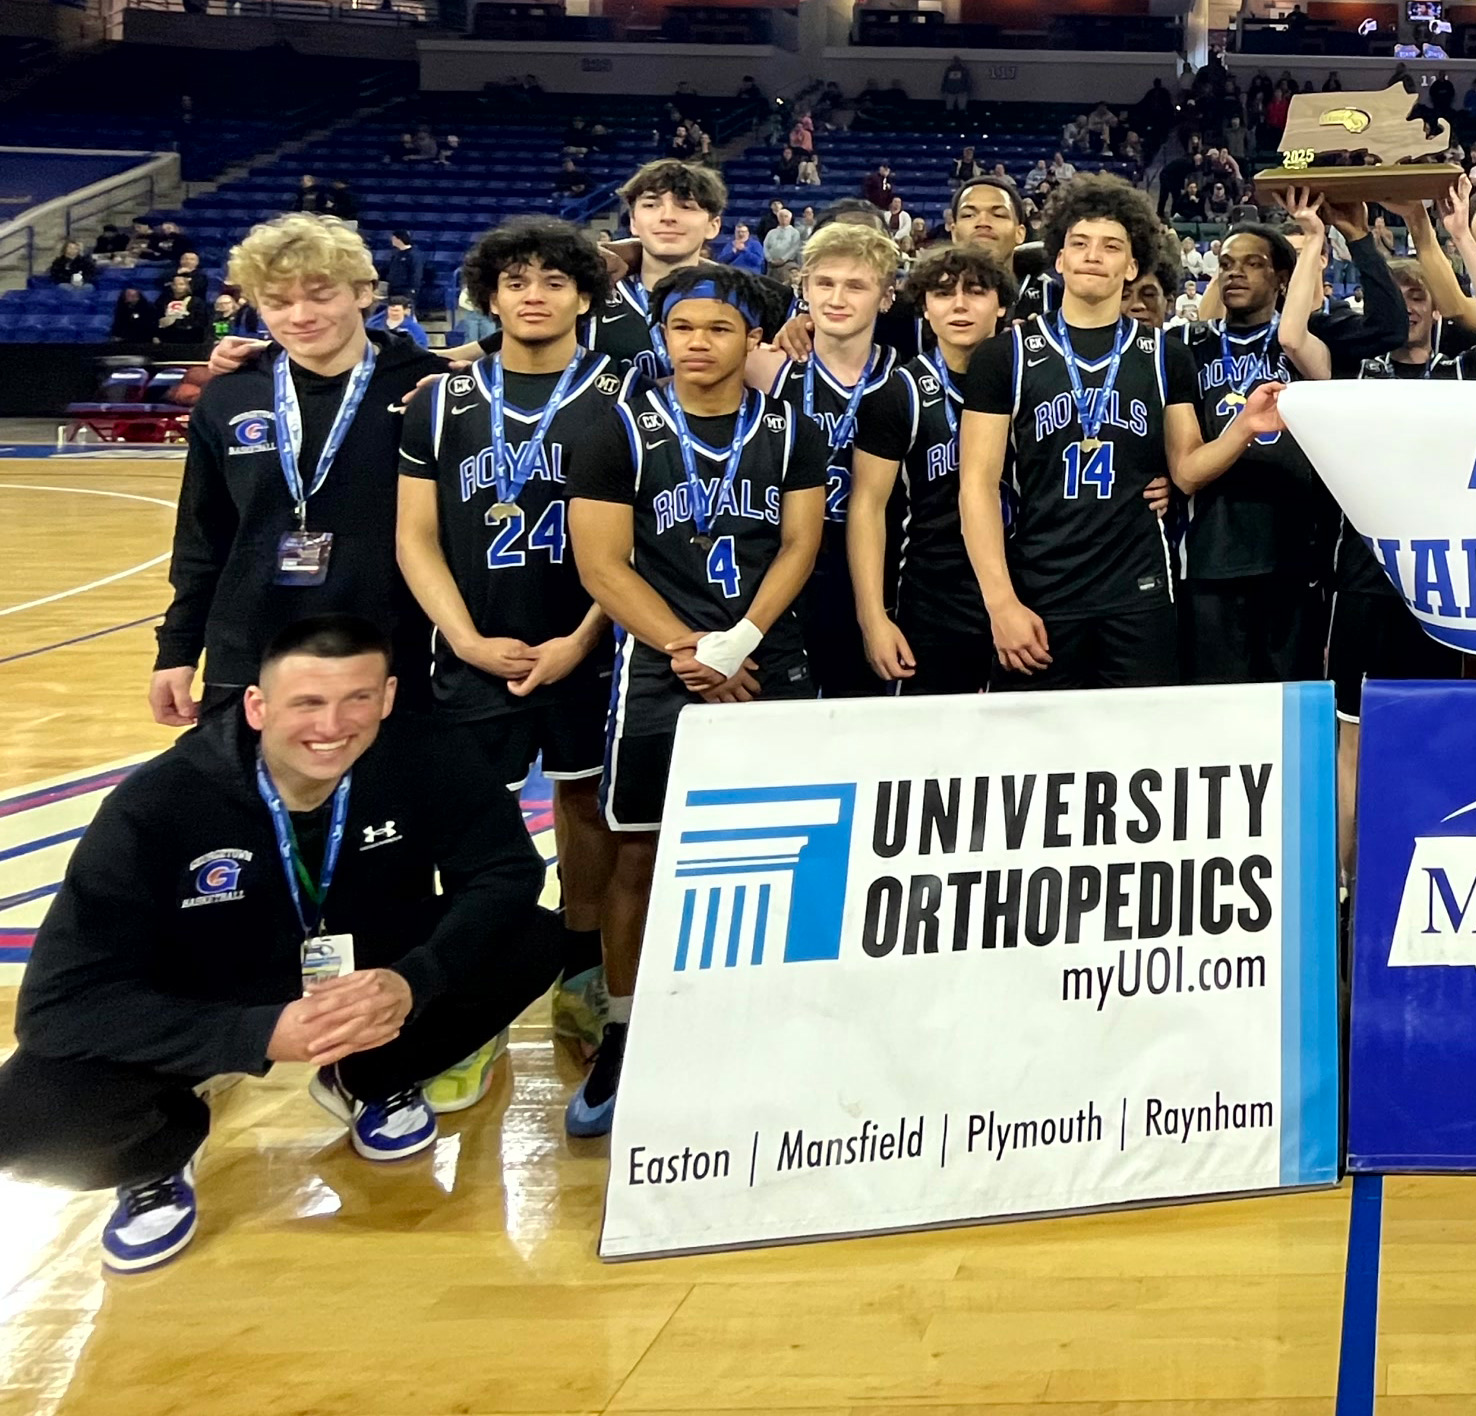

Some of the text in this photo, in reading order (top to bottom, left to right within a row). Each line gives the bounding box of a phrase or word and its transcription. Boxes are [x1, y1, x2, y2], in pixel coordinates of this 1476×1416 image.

[1283, 148, 1315, 165] 2025
[596, 376, 619, 392] MT
[765, 417, 783, 431] MT
[460, 442, 568, 503] ROYAL
[1062, 441, 1115, 499] 14
[484, 500, 567, 570] 24
[653, 478, 781, 535] ROYALS
[706, 535, 741, 600] 4
[872, 762, 1274, 858] UNIVERSITY
[196, 858, 242, 895] G
[861, 854, 1274, 959] ORTHOPEDICS
[1062, 947, 1267, 1011] myUOI.com
[629, 1146, 730, 1186] Easton
[777, 1121, 924, 1173] Mansfield
[967, 1101, 1103, 1162] Plymouth
[1145, 1093, 1274, 1149] Raynham
